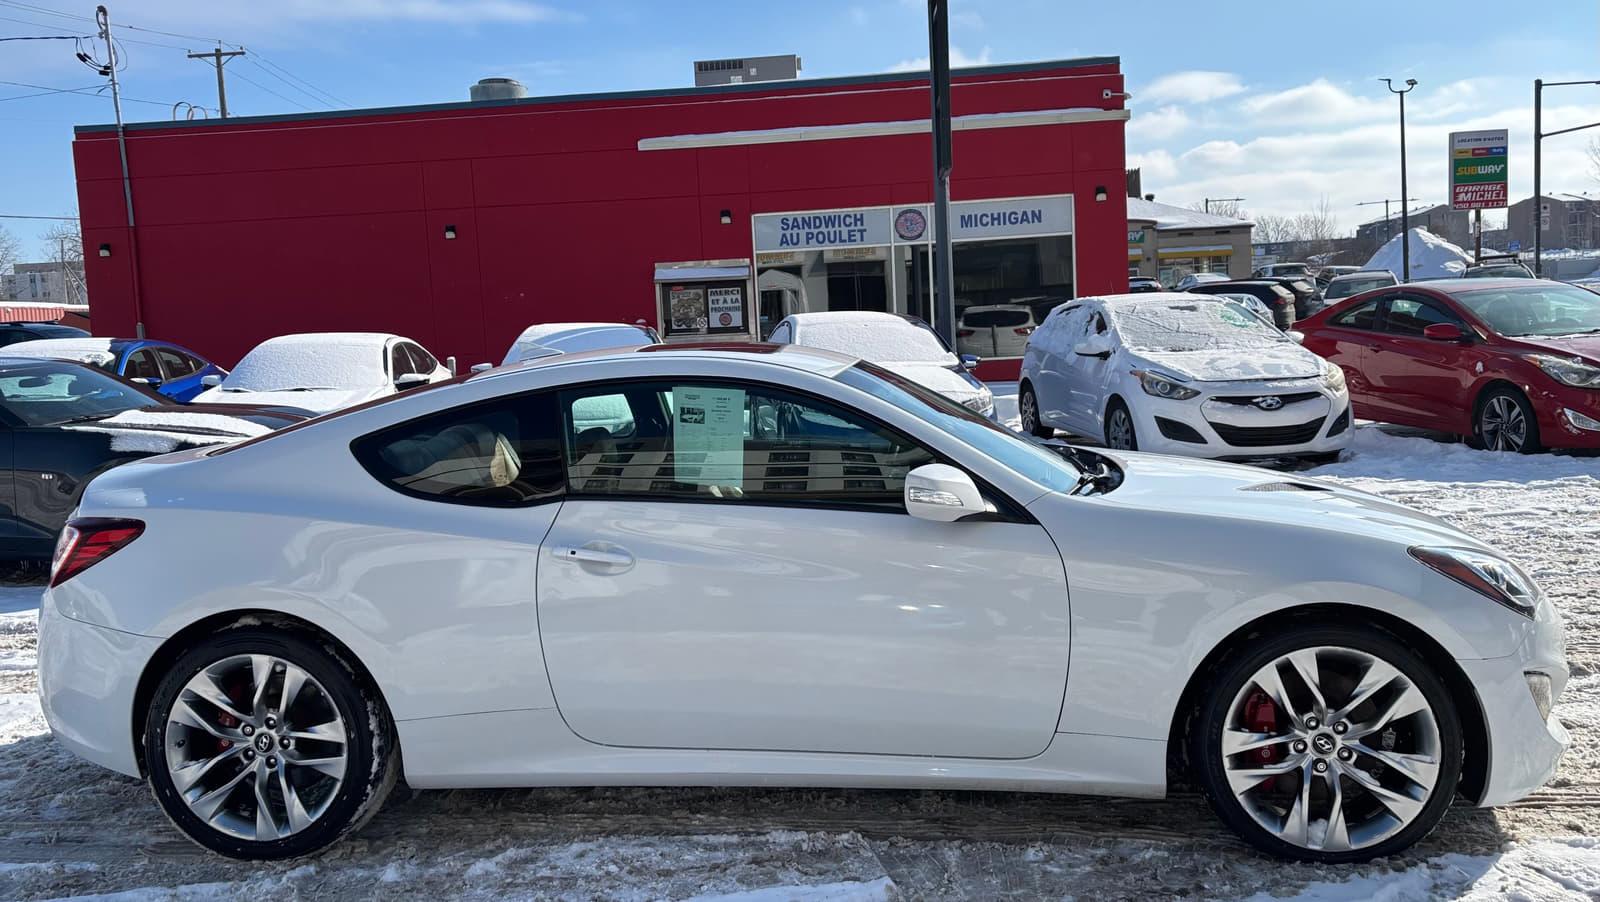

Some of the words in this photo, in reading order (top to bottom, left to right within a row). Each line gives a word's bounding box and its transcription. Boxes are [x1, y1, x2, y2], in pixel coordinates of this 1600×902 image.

[1456, 165, 1504, 175] SUBWAY
[1456, 190, 1506, 201] MICHEL
[780, 214, 864, 231] SANDWICH
[960, 209, 1042, 229] MICHIGAN
[779, 232, 801, 246] AU
[805, 229, 867, 245] POULET
[722, 296, 729, 304] À
